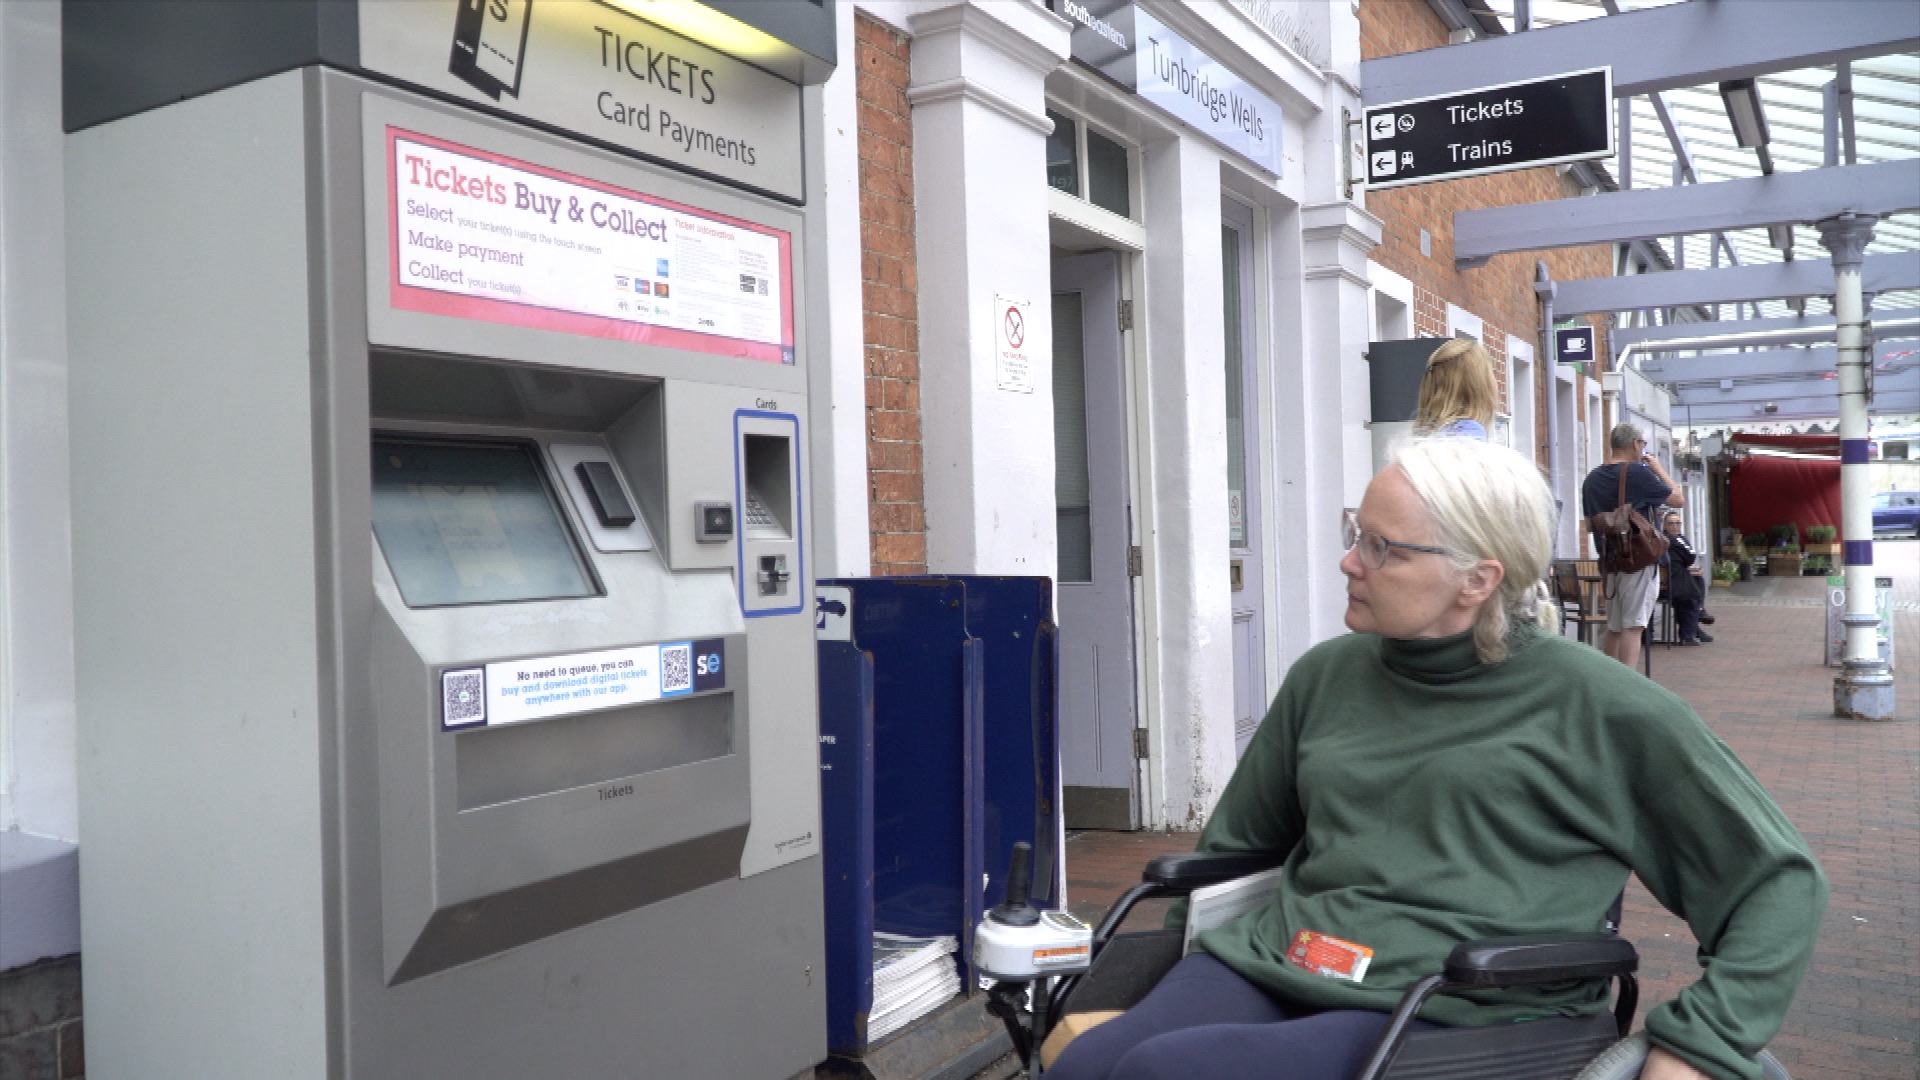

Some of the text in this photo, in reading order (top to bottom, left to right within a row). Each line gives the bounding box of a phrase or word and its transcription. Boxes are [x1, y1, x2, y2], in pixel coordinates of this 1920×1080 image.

[594, 26, 716, 105] TICKETS
[1149, 35, 1264, 141] Tunbridge Wells
[1447, 98, 1524, 125] Tickets
[597, 92, 756, 166] Card Payments
[1448, 139, 1513, 163] Trains
[405, 154, 667, 242] Tickets Buy & Collect
[407, 199, 454, 224] Select
[458, 217, 477, 229] your
[514, 229, 537, 243] using
[539, 233, 552, 245] the
[408, 230, 524, 266] Make payment
[408, 260, 464, 285] Collect
[467, 277, 487, 289] your
[755, 397, 777, 411] Cards
[517, 671, 530, 681] No
[533, 667, 556, 680] need
[558, 666, 567, 676] to
[601, 661, 616, 673] you
[618, 660, 634, 669] can
[697, 653, 721, 676] se
[501, 669, 648, 697] buy and download digital tickets
[525, 691, 570, 706] anywhere
[572, 687, 591, 699] with
[593, 685, 607, 695] our
[598, 784, 634, 802] Tickets
